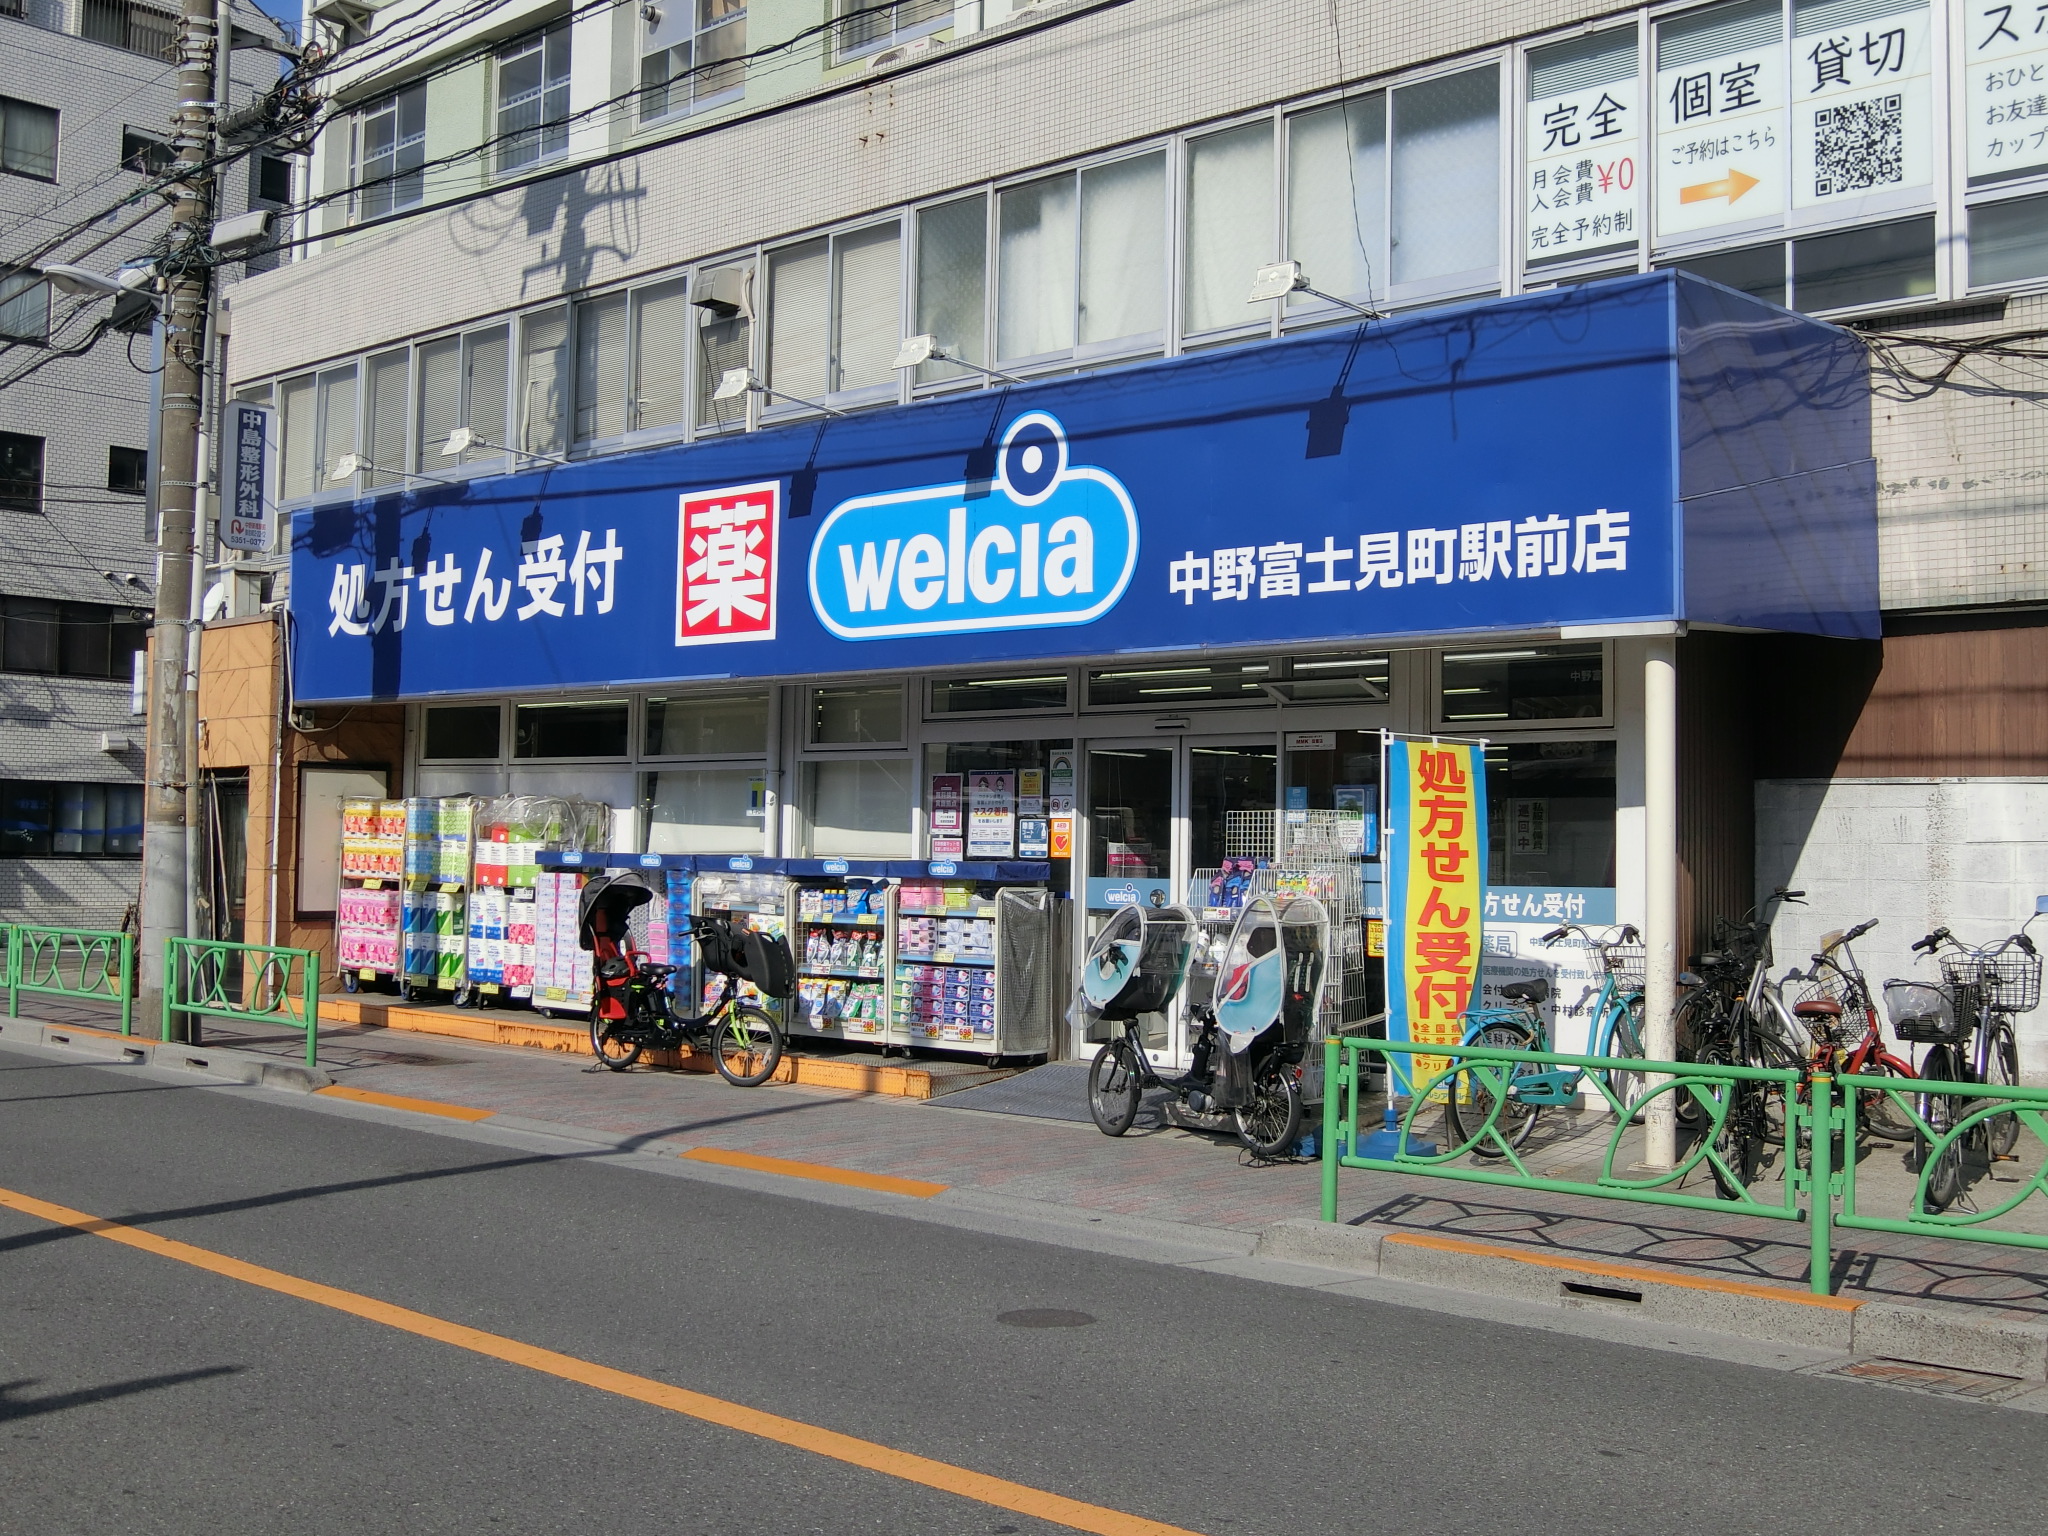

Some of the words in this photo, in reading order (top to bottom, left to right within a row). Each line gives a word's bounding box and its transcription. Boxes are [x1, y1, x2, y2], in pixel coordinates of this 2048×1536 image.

[1807, 27, 1906, 93] 貸切
[1985, 63, 2044, 92] おひと
[1669, 62, 1762, 125] 個室
[1986, 94, 2048, 125] お友達
[1543, 92, 1628, 151] 完全
[1672, 126, 1775, 165] ご予約はこちら
[1532, 159, 1594, 191] 月会費
[1597, 157, 1634, 194] ¥0
[1530, 182, 1594, 213] 入会費
[1531, 208, 1633, 250] 完全予約制
[239, 411, 262, 518] 中島整形外科
[231, 536, 265, 546] 5351-0377
[839, 507, 1094, 613] welcia
[1169, 508, 1630, 606] 中野富士見町駅前店
[329, 528, 623, 638] 処方せん受付
[686, 501, 767, 627] 薬
[1108, 892, 1136, 903] welcia
[1414, 750, 1472, 1020] 処方せん受付
[1485, 891, 1586, 919] 方せん受付
[959, 1028, 972, 1037] 698
